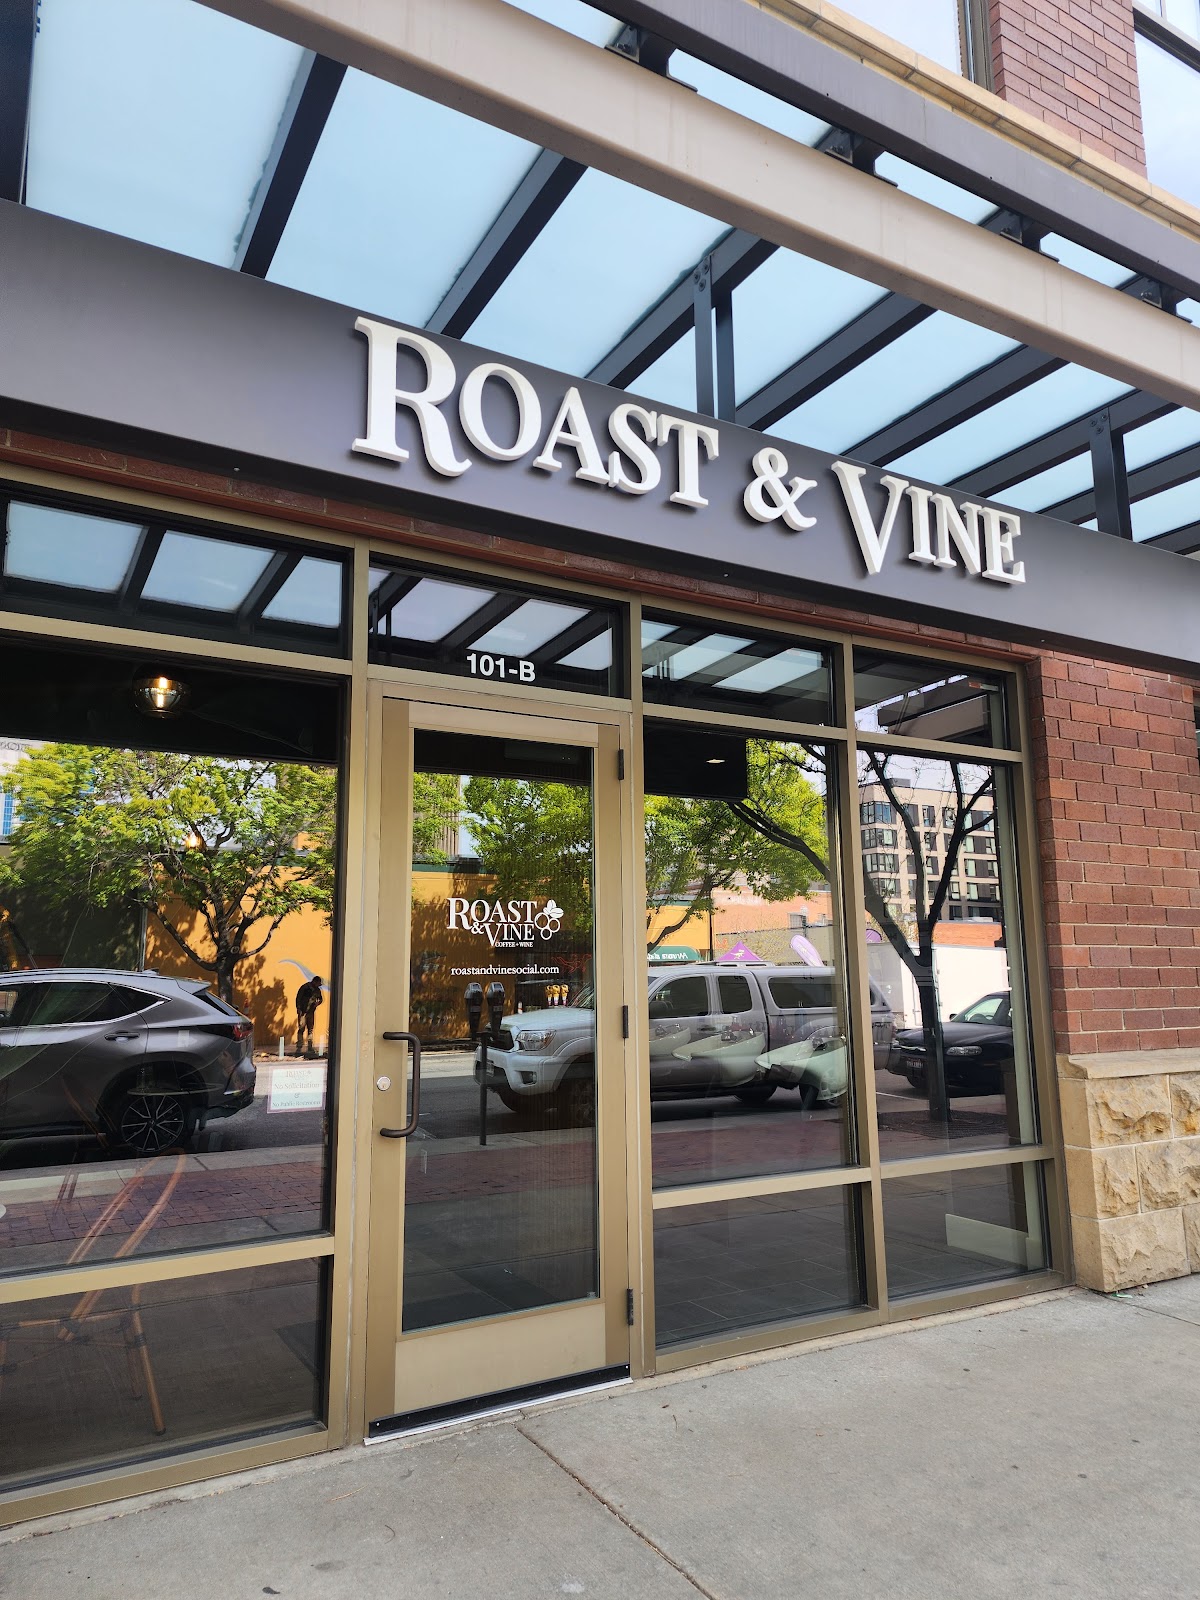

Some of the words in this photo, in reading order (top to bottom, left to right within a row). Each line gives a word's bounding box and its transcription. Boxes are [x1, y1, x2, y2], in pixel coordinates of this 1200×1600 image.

[351, 315, 719, 509] ROAST
[743, 446, 818, 533] &
[831, 460, 1027, 586] VINE
[466, 653, 536, 682] 101-B
[446, 897, 538, 930] ROAST
[470, 921, 485, 935] &
[483, 923, 535, 947] VINE
[451, 964, 560, 976] roastandvinesocial.com
[284, 1082, 320, 1090] Solicitation
